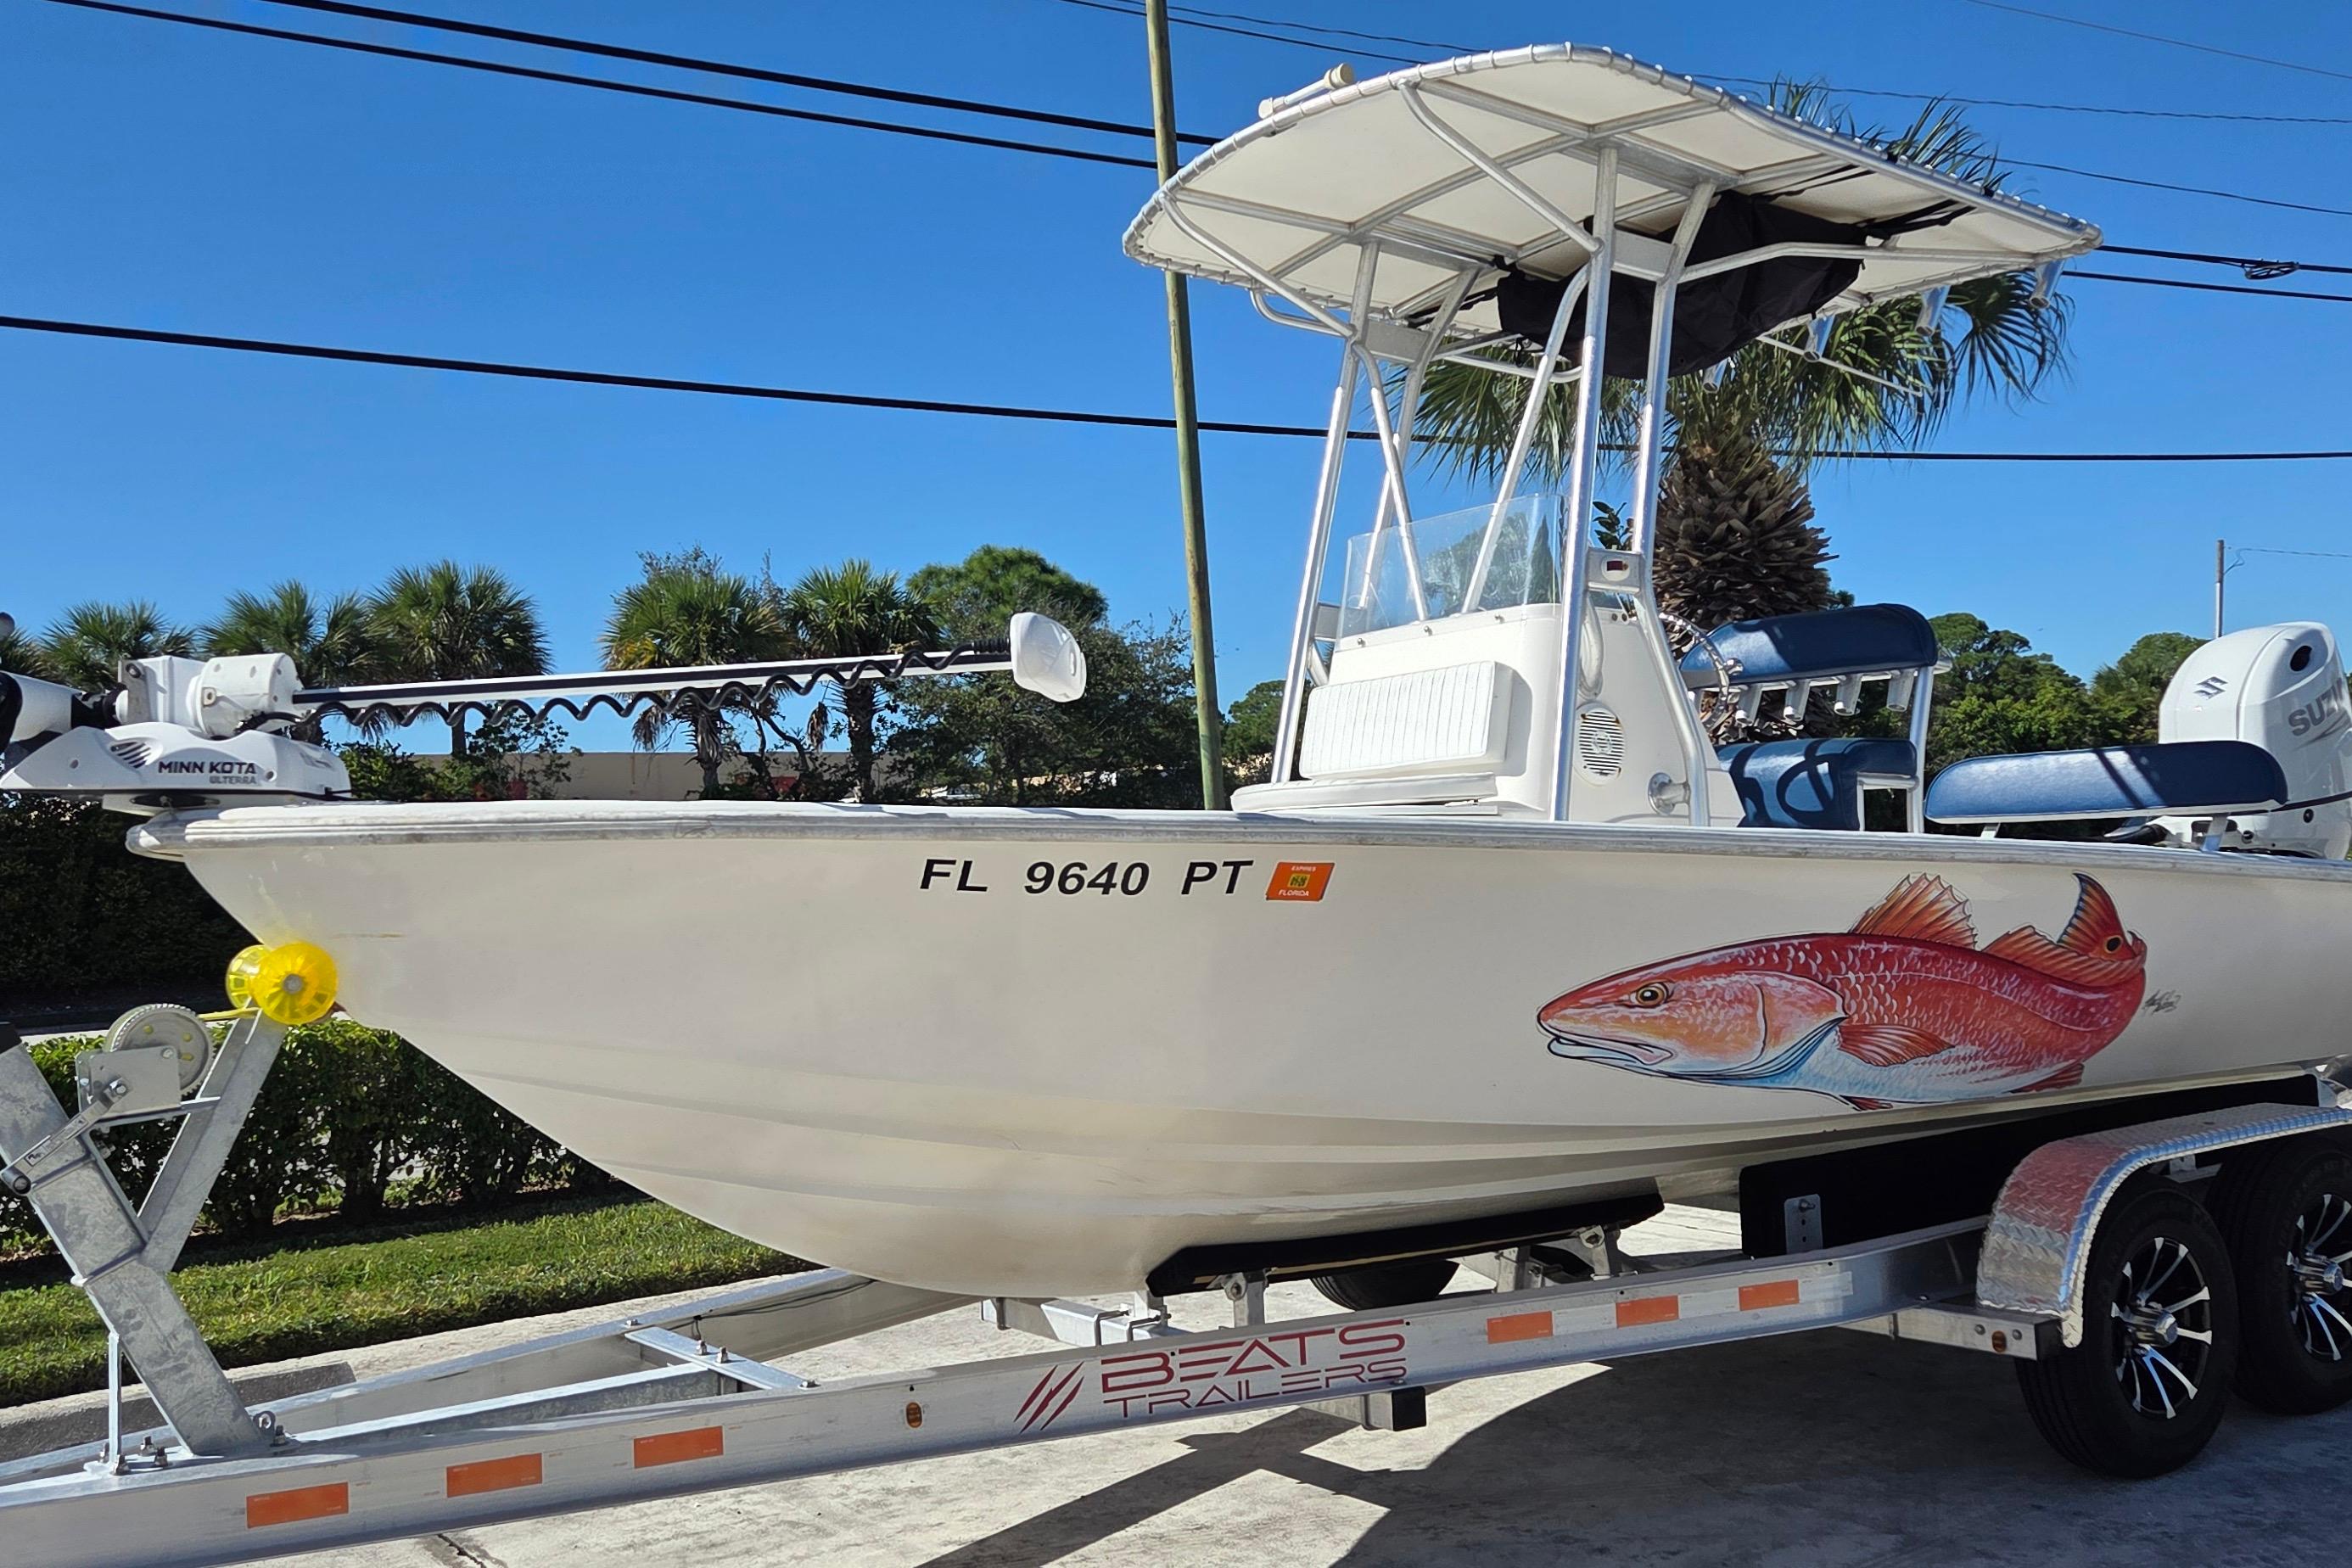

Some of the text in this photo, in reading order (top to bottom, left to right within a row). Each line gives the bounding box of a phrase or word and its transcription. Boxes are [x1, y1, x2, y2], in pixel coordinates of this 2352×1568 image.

[158, 761, 257, 774] MINN KOTA
[919, 858, 1255, 896] FL 9640 PT
[1100, 1318, 1405, 1394] BEATS
[1102, 1357, 1408, 1419] TRAILERS
